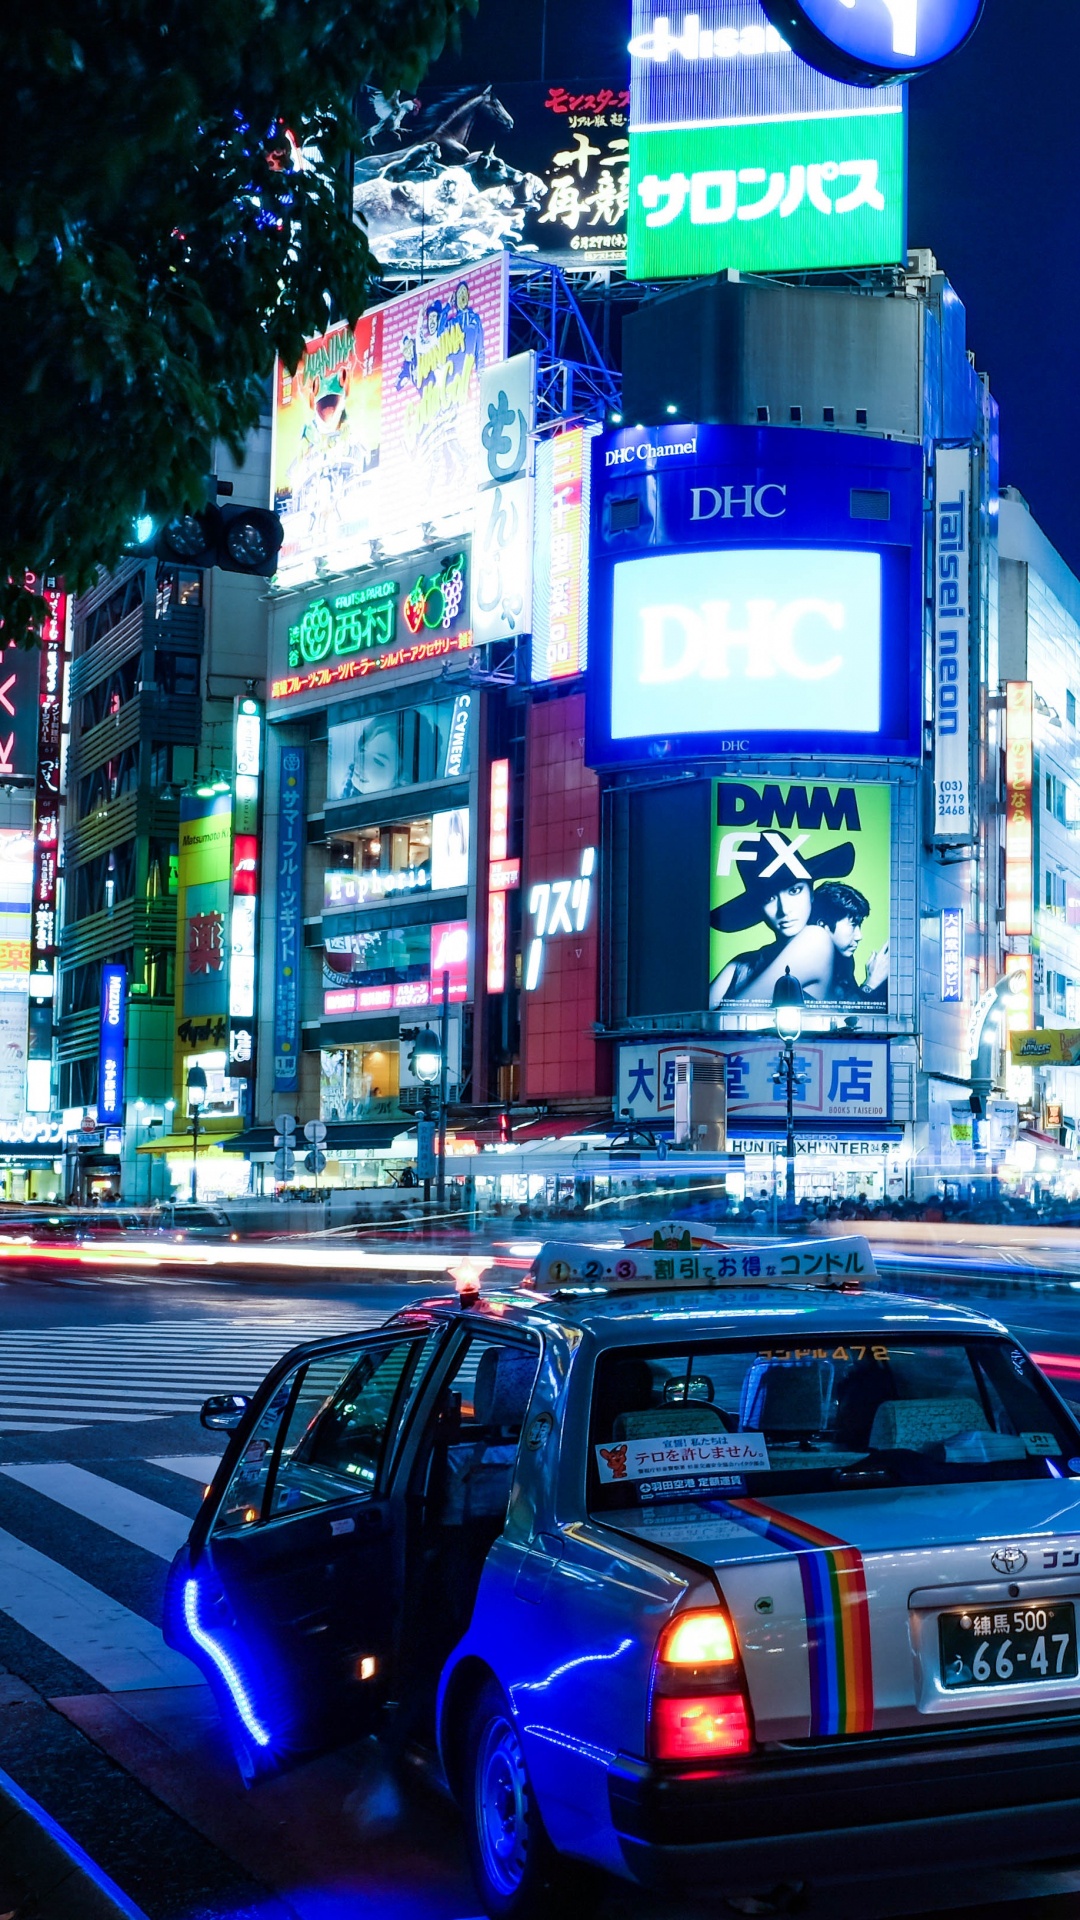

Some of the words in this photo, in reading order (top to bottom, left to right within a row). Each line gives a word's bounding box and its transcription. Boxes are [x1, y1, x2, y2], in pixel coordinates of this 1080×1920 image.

[637, 158, 886, 227] サロンパス
[605, 446, 635, 467] DHC
[636, 438, 697, 460] Channel
[477, 390, 528, 630] もんじゃ
[689, 484, 787, 520] DHC
[939, 490, 966, 619] Taisei
[289, 626, 300, 667] 渋谷
[335, 600, 395, 655] 西村
[638, 598, 844, 684] DHC
[938, 630, 961, 737] neon
[721, 740, 750, 751] DHC
[717, 782, 861, 831] DMM
[938, 794, 965, 805] 3719
[940, 781, 963, 793] (03)
[938, 805, 965, 817] 2468
[182, 832, 221, 847] Matsumoto
[716, 832, 812, 879] FX
[279, 791, 300, 962] サマーフルーツギフト
[330, 864, 427, 903] Euphoria
[189, 910, 225, 975] 薬
[109, 976, 121, 1025] MIZUHO
[828, 1106, 850, 1114] BOOKS
[853, 1106, 883, 1115] TAISEIDO
[831, 1345, 891, 1361] 472
[635, 1445, 764, 1466] テロを許しません。
[691, 1436, 729, 1446] 私たちは
[651, 1478, 696, 1492] 羽田空港
[973, 1613, 1010, 1637] 練馬
[1013, 1610, 1047, 1633] 500
[972, 1633, 1070, 1681] 66-47
